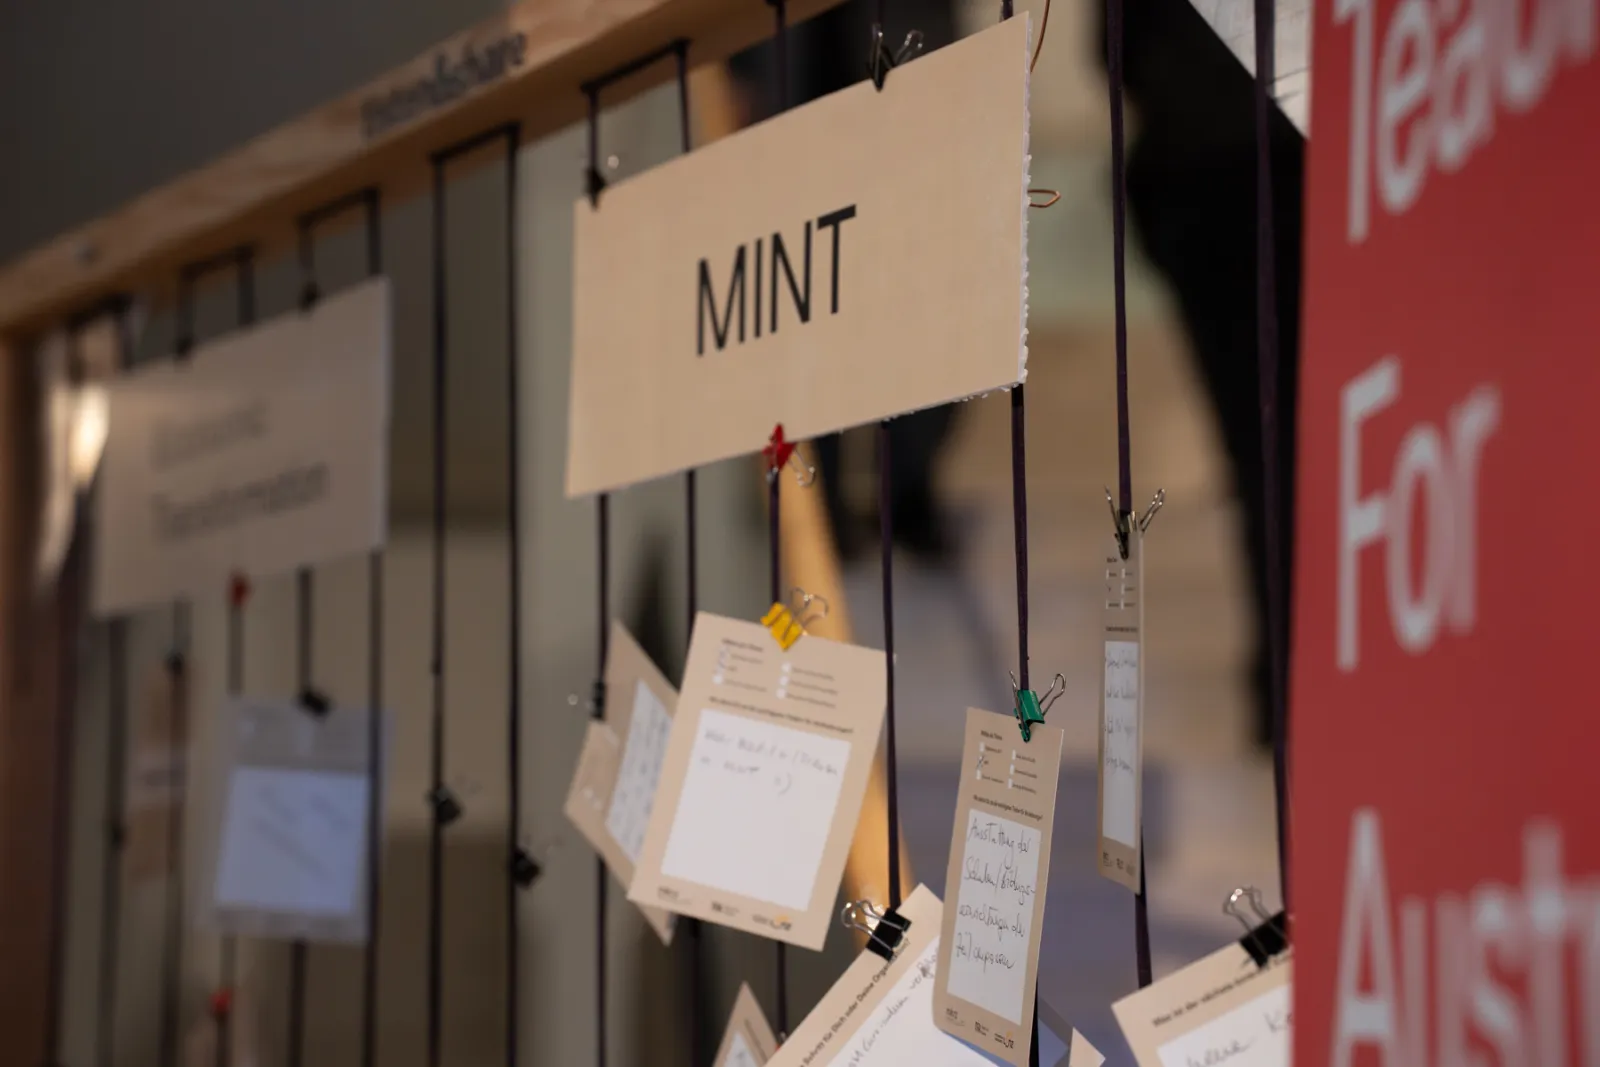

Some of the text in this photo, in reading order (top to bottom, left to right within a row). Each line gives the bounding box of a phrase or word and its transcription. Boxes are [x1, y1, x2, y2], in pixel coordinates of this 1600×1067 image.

[1334, 0, 1600, 245] Teac
[696, 203, 858, 358] MINT
[1336, 357, 1502, 671] For
[856, 982, 875, 1002] Deine
